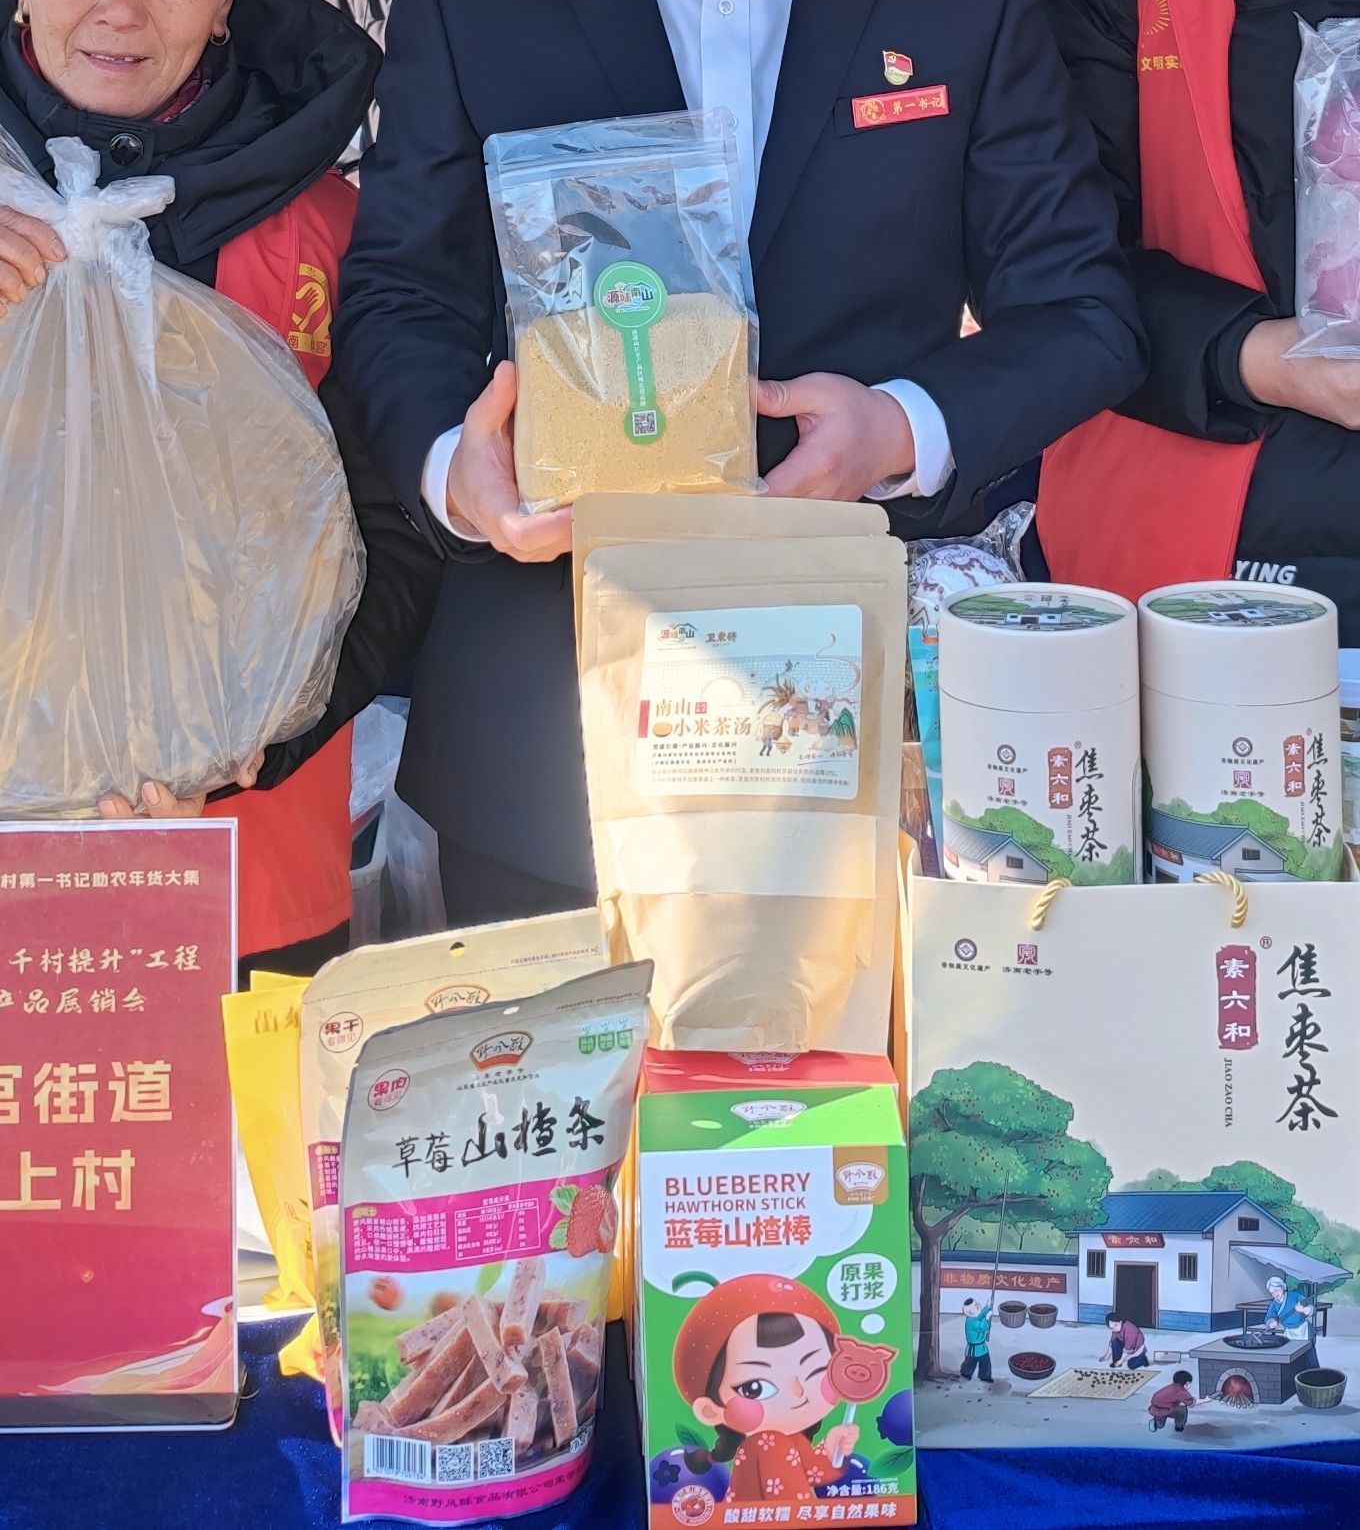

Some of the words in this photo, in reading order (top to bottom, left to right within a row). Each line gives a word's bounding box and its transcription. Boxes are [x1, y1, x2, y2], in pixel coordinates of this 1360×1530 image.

[1230, 560, 1298, 586] YING
[655, 698, 691, 717] 南山
[674, 716, 752, 737] 小米茶汤
[1219, 957, 1252, 1042] 素六和
[323, 1017, 361, 1036] 果干
[1276, 942, 1339, 1132] 焦枣茶
[1222, 1057, 1233, 1082] JIAO
[373, 1075, 409, 1099] 果肉
[1222, 1084, 1233, 1105] ZAO
[1222, 1106, 1233, 1128] CHA
[392, 1096, 607, 1179] 草莓山楂条
[665, 1172, 811, 1197] BLUEBERRY
[665, 1200, 757, 1214] HAWTHORN
[761, 1197, 807, 1210] STICK
[664, 1217, 812, 1250] 蓝莓山楂棒
[839, 1262, 885, 1282] 原果
[942, 1271, 1061, 1290] 非物质文化遗产
[840, 1282, 885, 1303] 打浆
[796, 1501, 898, 1522] 尽享自然果味
